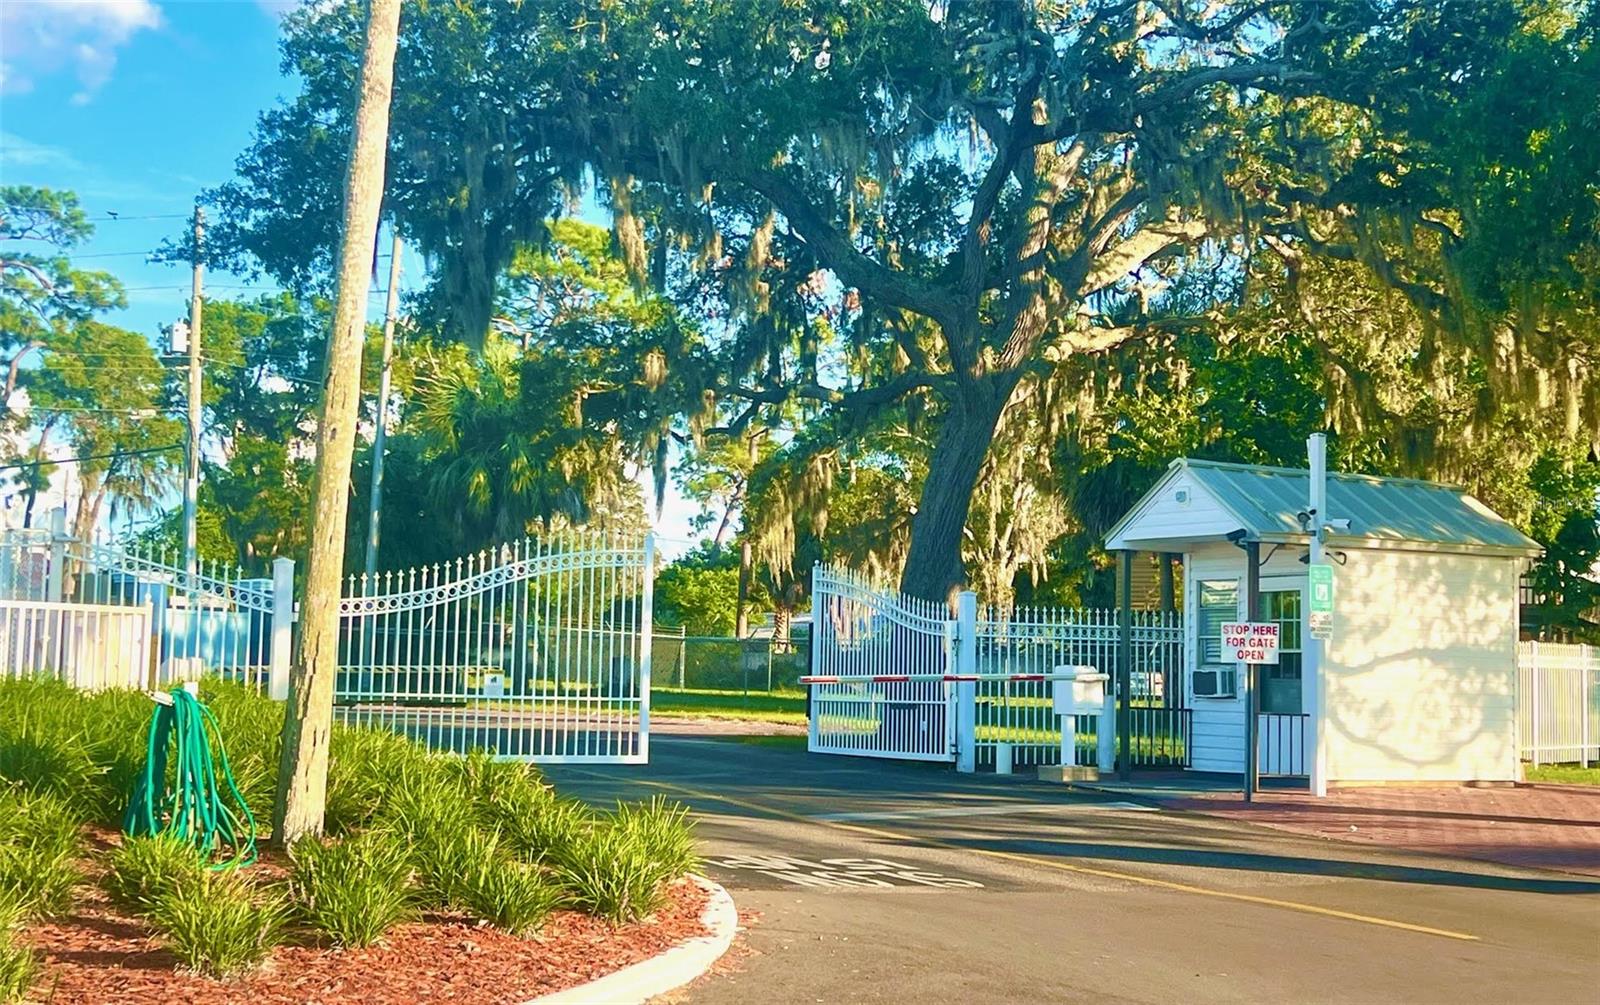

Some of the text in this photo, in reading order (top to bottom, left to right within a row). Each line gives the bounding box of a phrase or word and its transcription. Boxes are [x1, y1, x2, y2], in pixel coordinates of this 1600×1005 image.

[1223, 625, 1278, 636] STOP HERE
[1226, 637, 1275, 648] FOR GATE
[1237, 650, 1265, 660] OPEN
[755, 870, 985, 888] SLOW
